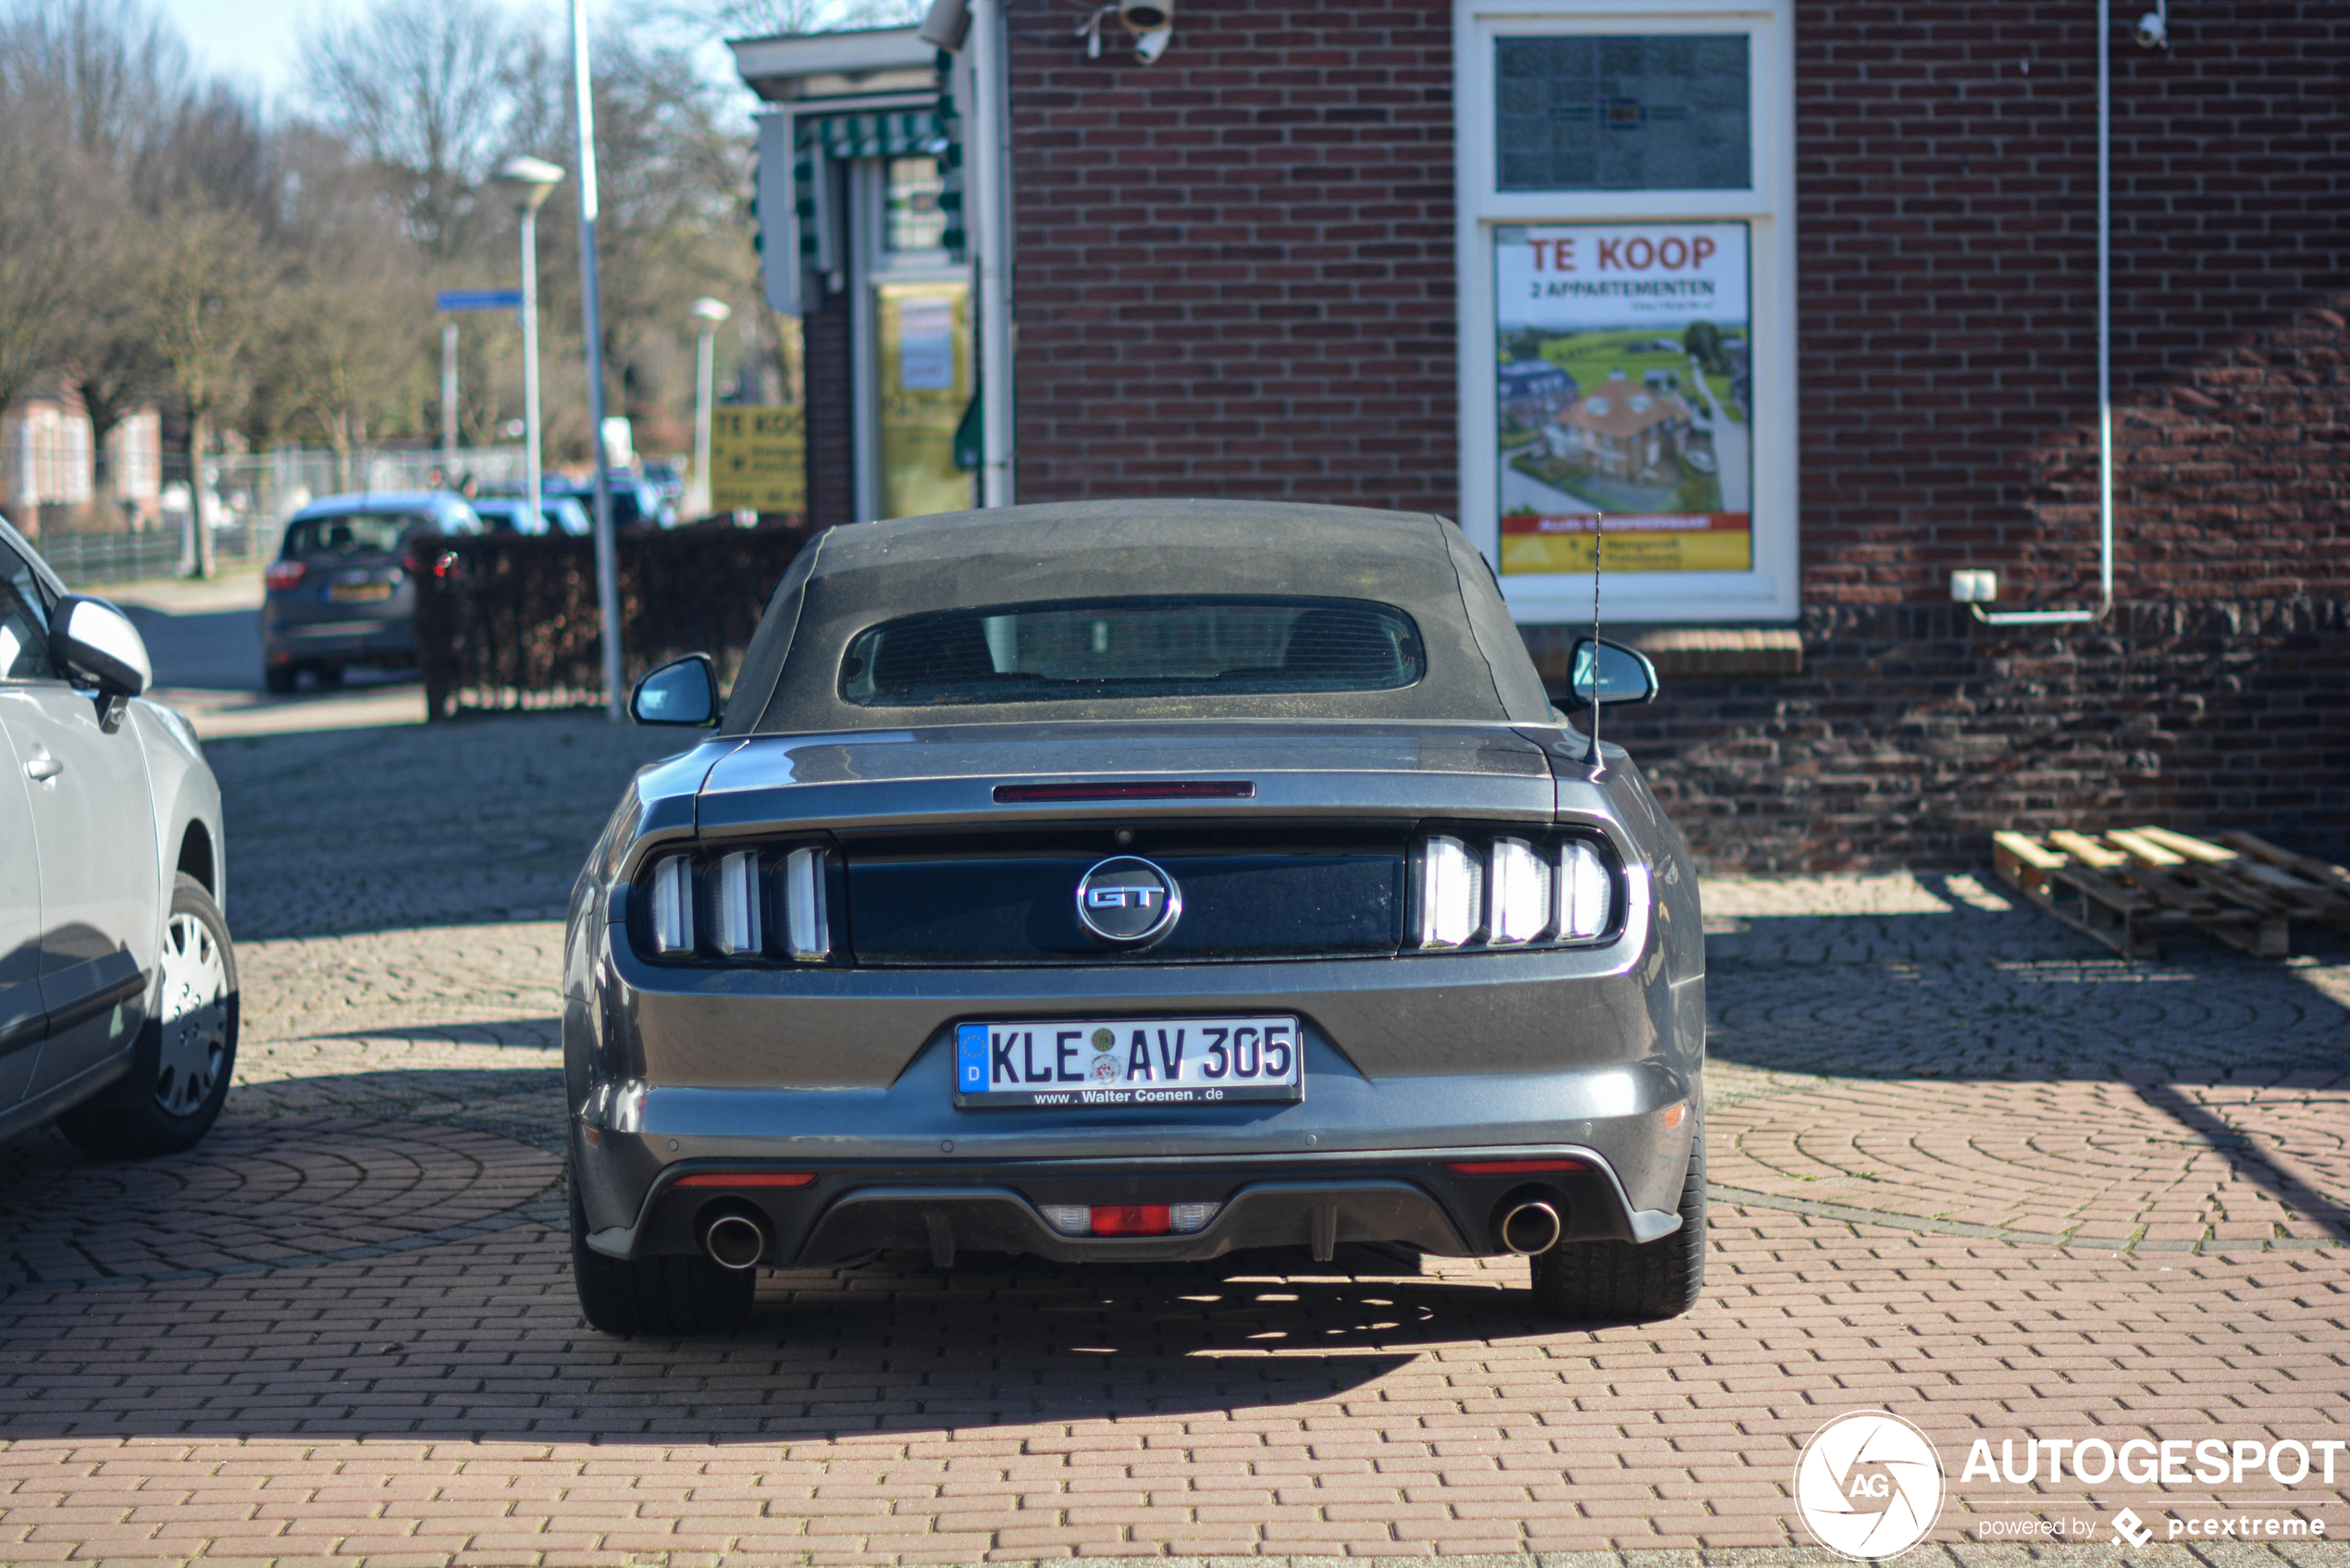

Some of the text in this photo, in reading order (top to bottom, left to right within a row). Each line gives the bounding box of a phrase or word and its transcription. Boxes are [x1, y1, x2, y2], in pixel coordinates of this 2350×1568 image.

[1528, 236, 1716, 271] TE KOOP
[1530, 279, 1715, 298] 2 APPARTEMENTEN
[1088, 886, 1165, 907] GT
[991, 1026, 1292, 1083] KLE AV 305
[968, 1067, 980, 1080] D
